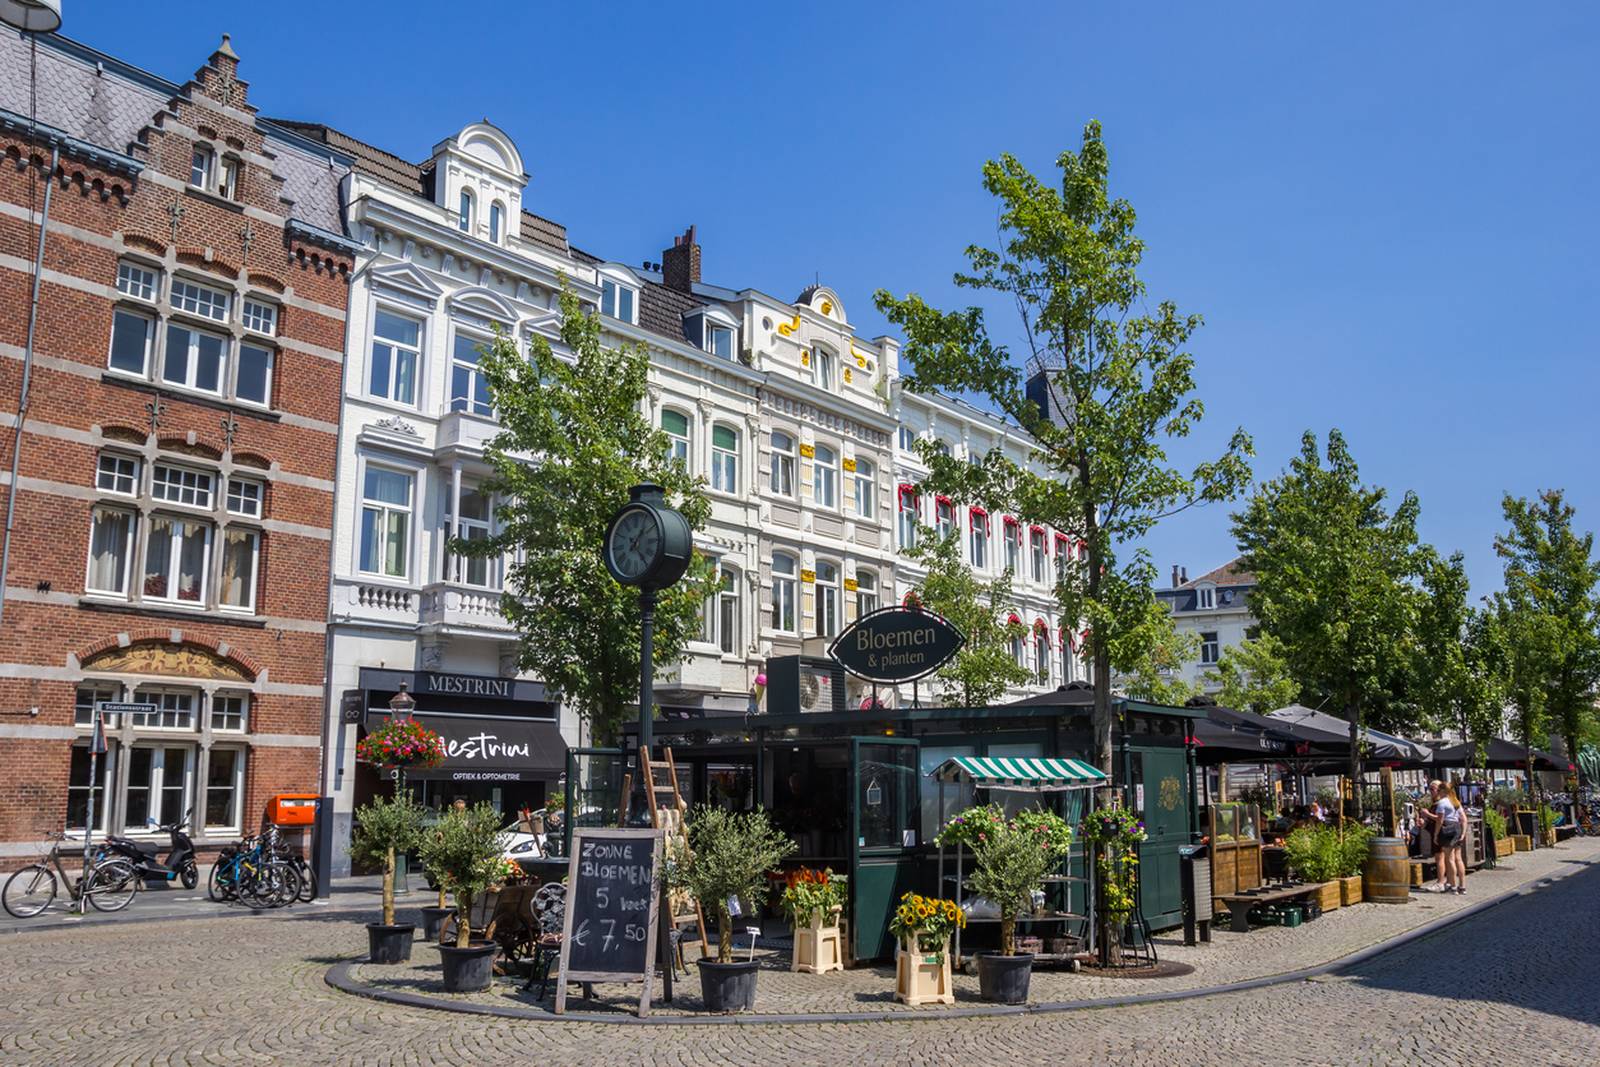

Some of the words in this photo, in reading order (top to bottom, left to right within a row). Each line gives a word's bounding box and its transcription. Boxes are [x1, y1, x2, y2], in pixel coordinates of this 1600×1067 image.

[857, 628, 935, 650] Bloemen
[868, 654, 877, 668] &
[881, 652, 924, 671] planten
[429, 675, 509, 696] MESTRINI
[482, 773, 520, 781] OPTOMETRIE
[582, 843, 632, 860] ZONNE
[596, 887, 609, 909] 5
